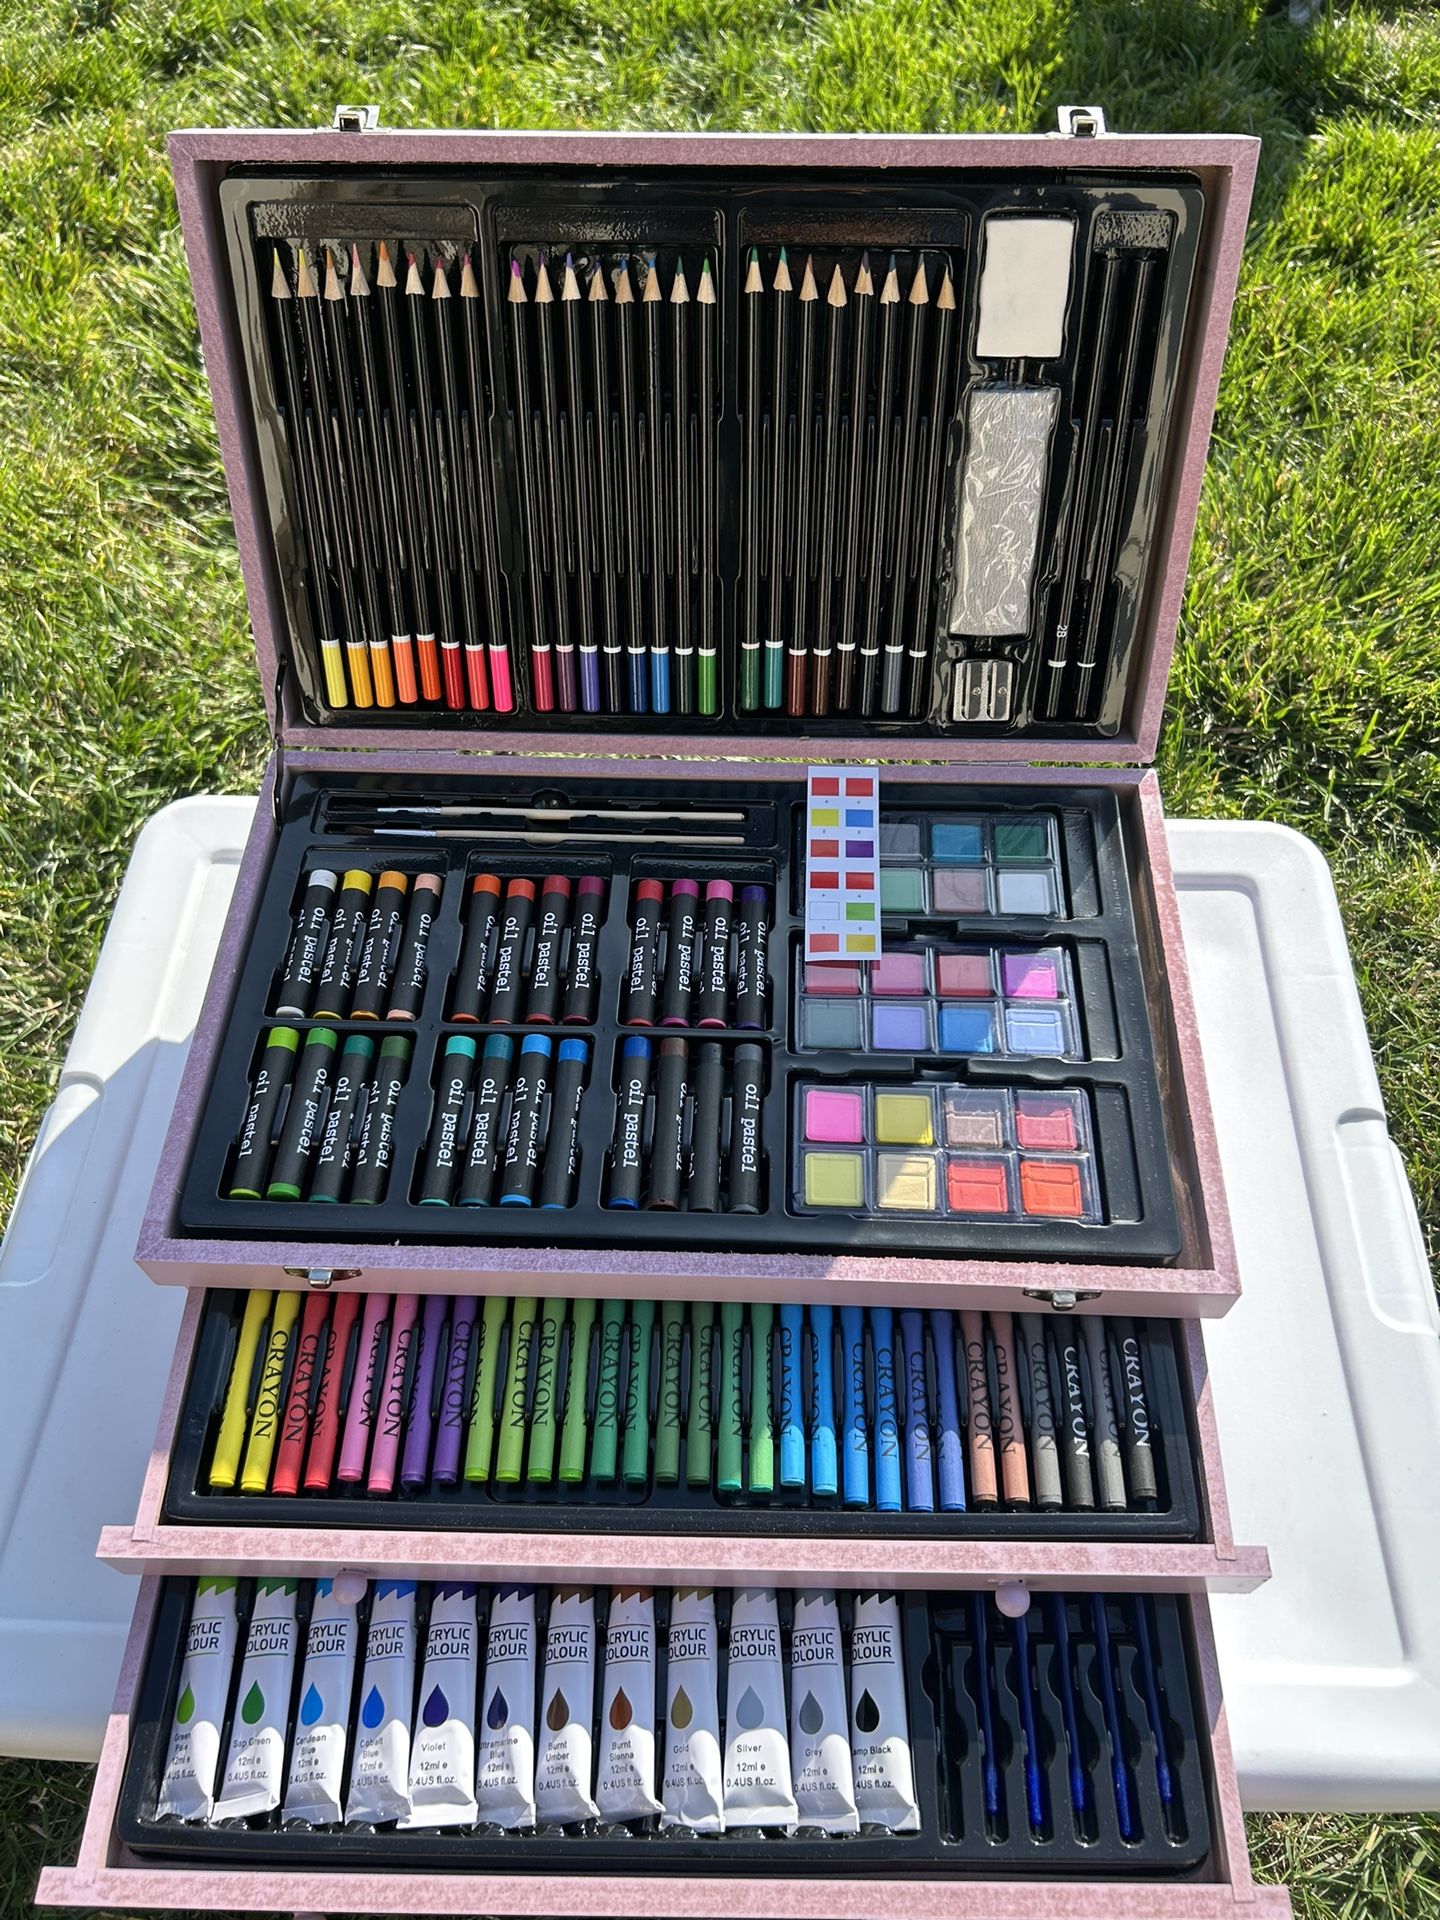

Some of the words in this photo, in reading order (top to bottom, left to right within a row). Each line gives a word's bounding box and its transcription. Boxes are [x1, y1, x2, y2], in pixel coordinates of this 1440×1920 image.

[1056, 624, 1069, 638] 2B
[310, 907, 326, 930] oil
[333, 908, 348, 932] oil
[369, 908, 383, 932] oil
[418, 913, 432, 937] oil
[503, 917, 520, 941] oil
[542, 912, 558, 936] oil
[581, 913, 596, 936] oil
[635, 917, 650, 942] oil
[682, 914, 695, 939] oil
[714, 916, 727, 940] oil
[739, 921, 751, 944] oil
[298, 935, 318, 984] pastel
[410, 942, 426, 989] pastel
[495, 946, 512, 994] pastel
[534, 941, 551, 989] pastel
[575, 942, 591, 989] pastel
[630, 945, 645, 994] pastel
[678, 943, 692, 993] pastel
[711, 945, 727, 994] pastel
[254, 1069, 271, 1096] oil
[312, 1068, 328, 1094] oil
[333, 1076, 352, 1104] oil
[386, 1079, 401, 1106] oil
[447, 1078, 465, 1106] oil
[480, 1078, 499, 1105] oil
[515, 1077, 529, 1103] oil
[628, 1079, 645, 1106] oil
[744, 1083, 760, 1110] oil
[239, 1103, 261, 1159] pastel
[296, 1099, 319, 1156] pastel
[319, 1109, 342, 1166] pastel
[375, 1112, 393, 1169] pastel
[436, 1112, 458, 1168] pastel
[470, 1112, 490, 1167] pastel
[622, 1112, 639, 1168] pastel
[740, 1117, 757, 1173] pastel
[444, 1319, 473, 1430] CRAYON
[510, 1320, 535, 1430] CRAYON
[533, 1317, 557, 1427] CRAYON
[598, 1320, 622, 1430] CRAYON
[664, 1320, 683, 1430] CRAYON
[254, 1329, 289, 1440] CRAYON
[284, 1333, 320, 1444] CRAYON
[384, 1328, 412, 1440] CRAYON
[1122, 1337, 1151, 1449] CRAYON
[877, 1346, 898, 1460] CRAYON
[910, 1351, 931, 1463] CRAYON
[966, 1341, 994, 1453] CRAYON
[1030, 1342, 1056, 1453] CRAYON
[1063, 1346, 1090, 1459] CRAYON
[188, 1621, 222, 1636] RYLIC
[250, 1622, 290, 1638] CRYLIC
[308, 1624, 347, 1640] CRYLIC
[367, 1626, 405, 1643] CRYLIC
[429, 1627, 471, 1642] CRYLIC
[488, 1628, 528, 1644] CRYLIC
[549, 1631, 588, 1646] CRYLIC
[668, 1628, 707, 1644] CRYLIC
[791, 1632, 834, 1648] CRYLIC
[852, 1630, 891, 1646] CRYLIC
[187, 1636, 219, 1652] LOUR
[247, 1638, 289, 1653] OLOUR
[306, 1639, 345, 1655] OLOUR
[366, 1641, 403, 1658] OLOUR
[425, 1642, 470, 1657] OLOUR
[487, 1643, 528, 1660] OLOUR
[545, 1645, 588, 1662] OLOUR
[668, 1643, 707, 1660] OLOUR
[852, 1645, 892, 1661] OLOUR
[249, 1737, 271, 1746] Green
[301, 1747, 316, 1756] Blue
[421, 1742, 446, 1752] Violet
[548, 1740, 567, 1751] Burnt
[611, 1740, 631, 1751] Burnt
[673, 1744, 689, 1754] Gold
[736, 1744, 762, 1753] Silver
[805, 1748, 823, 1758] Grey
[870, 1745, 892, 1755] Black
[172, 1756, 187, 1766] 12ml
[238, 1756, 255, 1766] 12ml
[297, 1758, 312, 1768] 12ml
[362, 1750, 379, 1759] Blue
[420, 1761, 440, 1771] 12ml
[490, 1751, 505, 1760] Blue
[545, 1752, 570, 1762] Umber
[609, 1752, 634, 1762] Sienna
[167, 1770, 181, 1780] .4US
[360, 1763, 376, 1772] 12ml
[487, 1763, 504, 1773] 12ml
[546, 1764, 563, 1775] 12ml
[611, 1764, 627, 1774] 12ml
[672, 1763, 688, 1773] 12ml
[737, 1762, 758, 1772] 12ml
[802, 1767, 821, 1777] 12ml
[858, 1765, 877, 1775] 12ml
[855, 1780, 873, 1790] .4US
